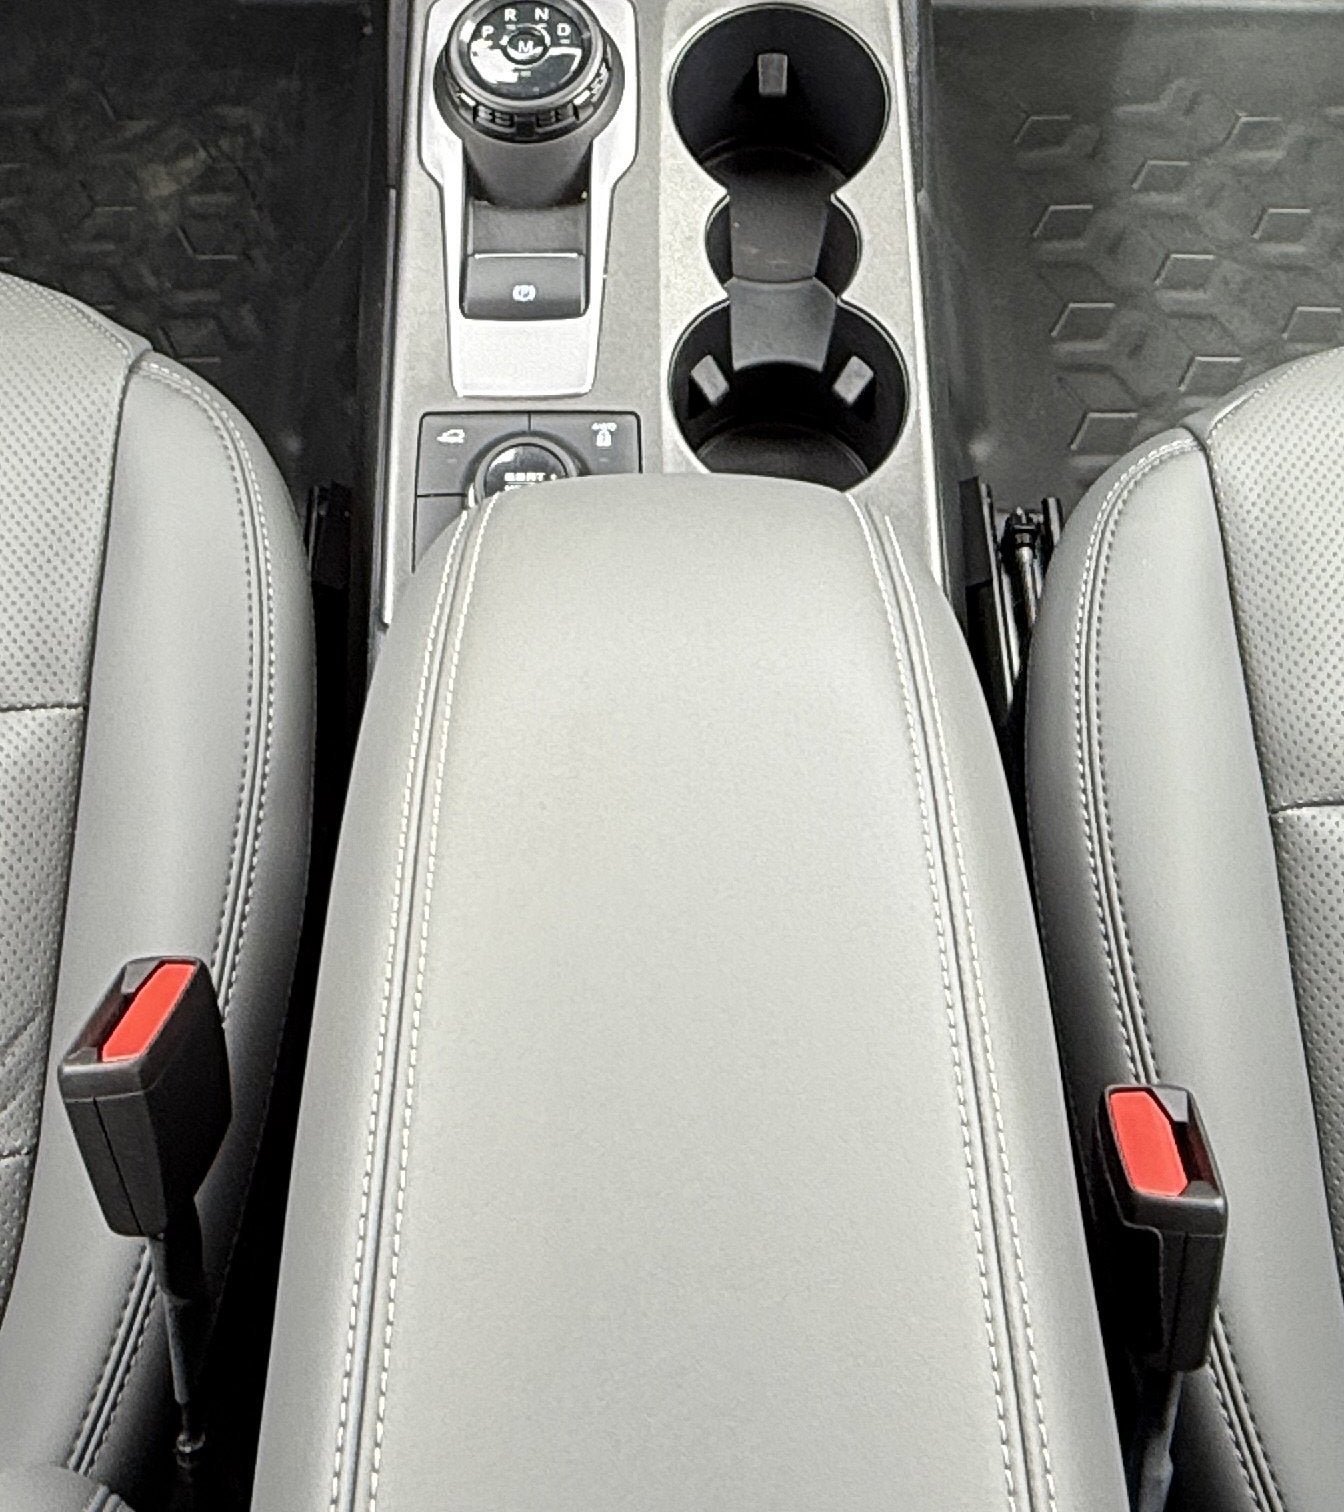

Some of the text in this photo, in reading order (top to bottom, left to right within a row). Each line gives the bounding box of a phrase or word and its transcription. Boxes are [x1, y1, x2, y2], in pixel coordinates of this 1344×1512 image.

[505, 8, 517, 21] R
[535, 7, 550, 20] N
[481, 25, 494, 38] P
[557, 23, 572, 36] D
[517, 40, 534, 54] M
